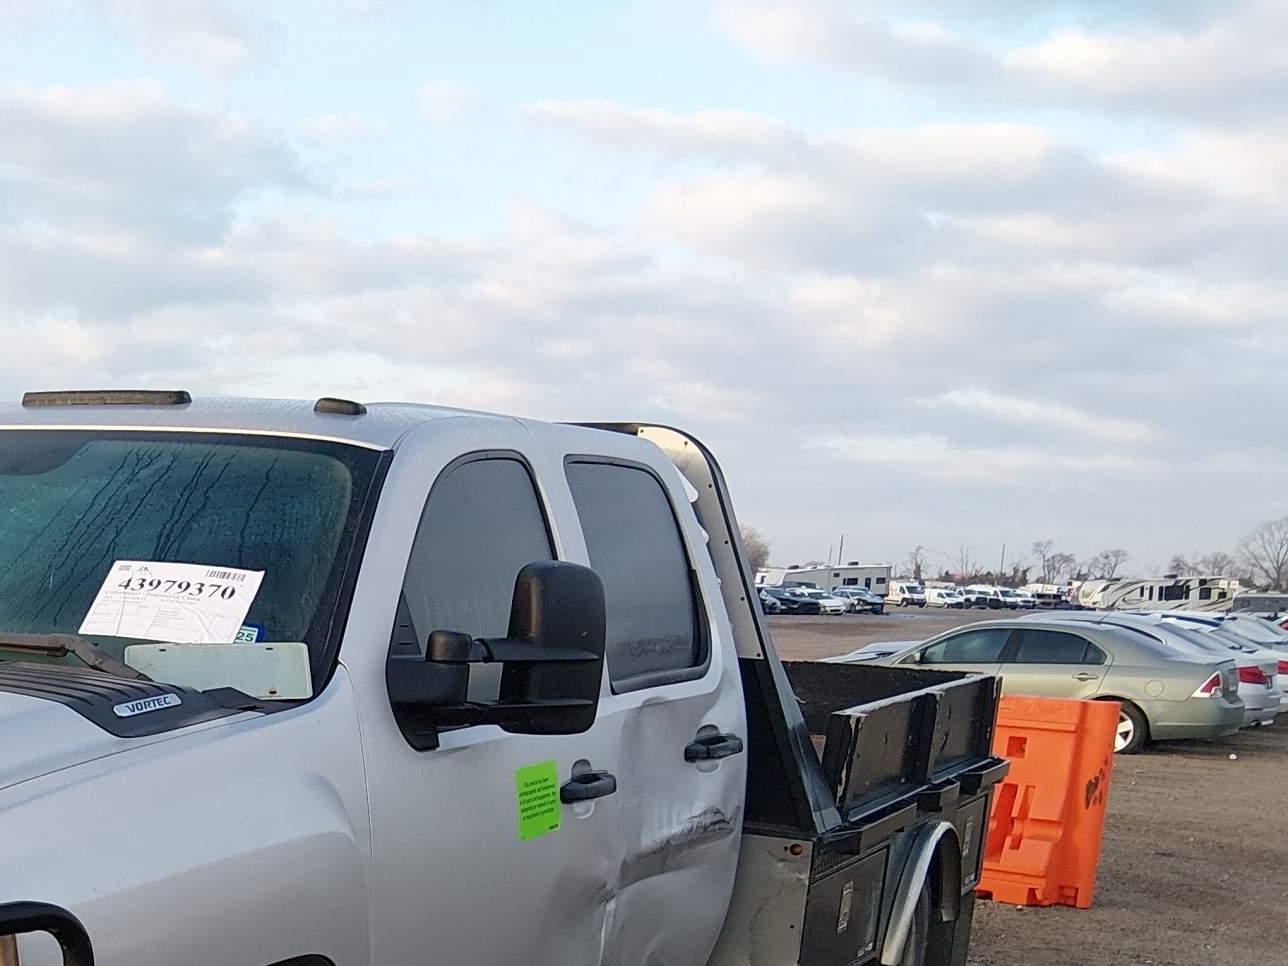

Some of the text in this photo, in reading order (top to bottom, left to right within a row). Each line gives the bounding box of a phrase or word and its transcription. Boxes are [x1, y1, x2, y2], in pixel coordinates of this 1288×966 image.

[118, 577, 237, 600] 43979370
[237, 632, 255, 642] 25
[127, 695, 172, 713] VORTEC
